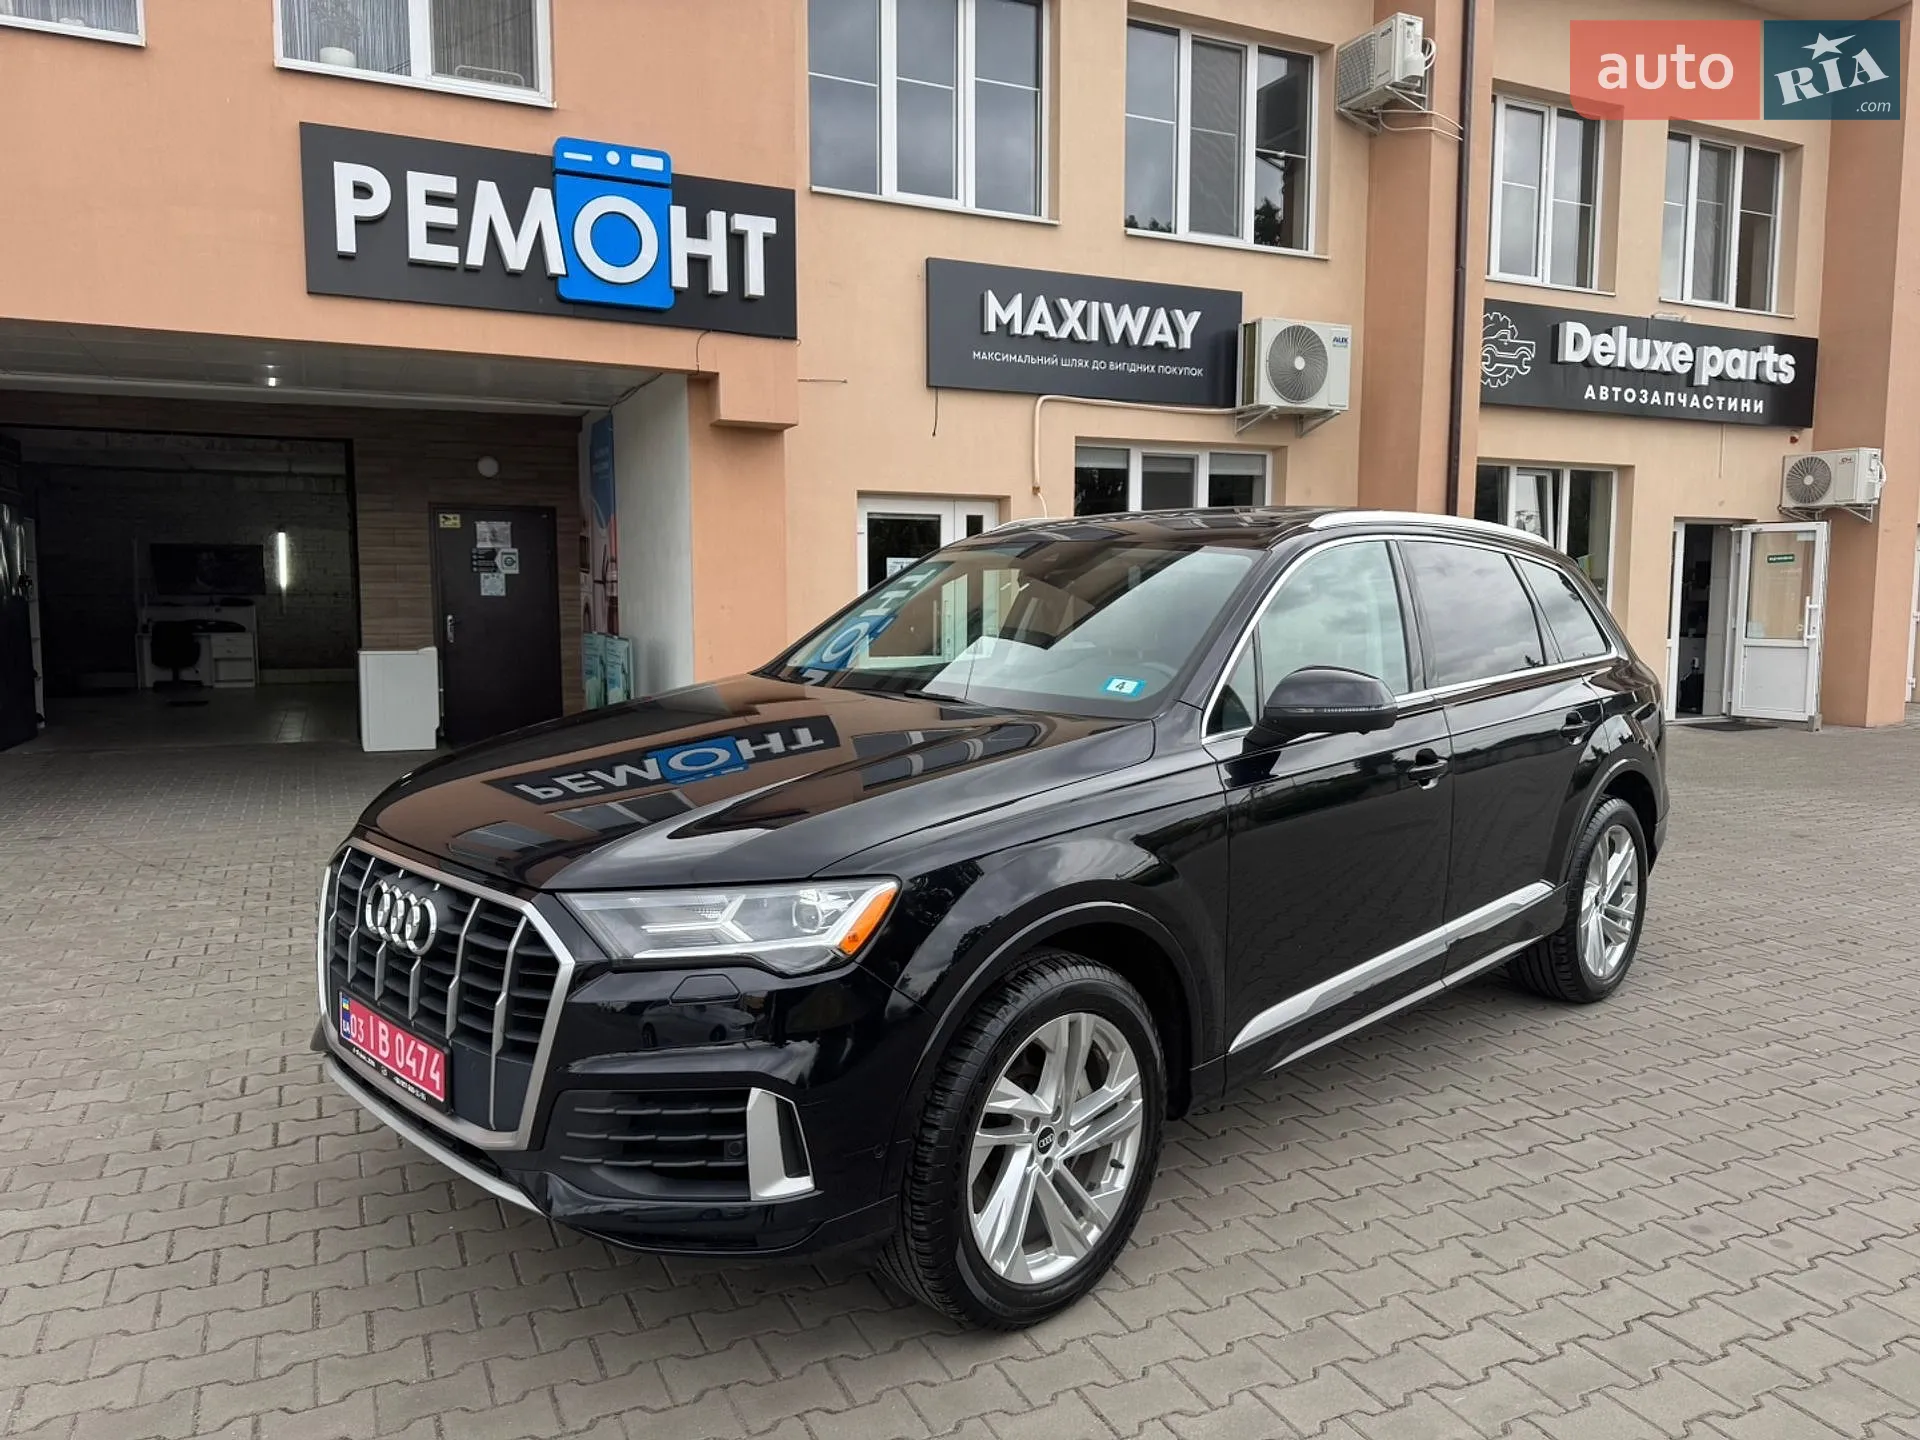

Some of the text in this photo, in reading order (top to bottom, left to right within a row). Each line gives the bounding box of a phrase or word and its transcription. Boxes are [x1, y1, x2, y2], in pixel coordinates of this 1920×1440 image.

[332, 161, 778, 299] РЕМОНТ
[983, 289, 1202, 350] MAXIWAY
[972, 350, 1204, 377] МАКСИМАЛЬНИЙ ШЛЯХ ДО ВИГІДНИХ ПОКУПОК
[1558, 320, 1796, 386] Deluxe parts
[1583, 383, 1765, 415] АВТОЗАПЧАСТИНИ
[395, 1032, 440, 1090] 0474
